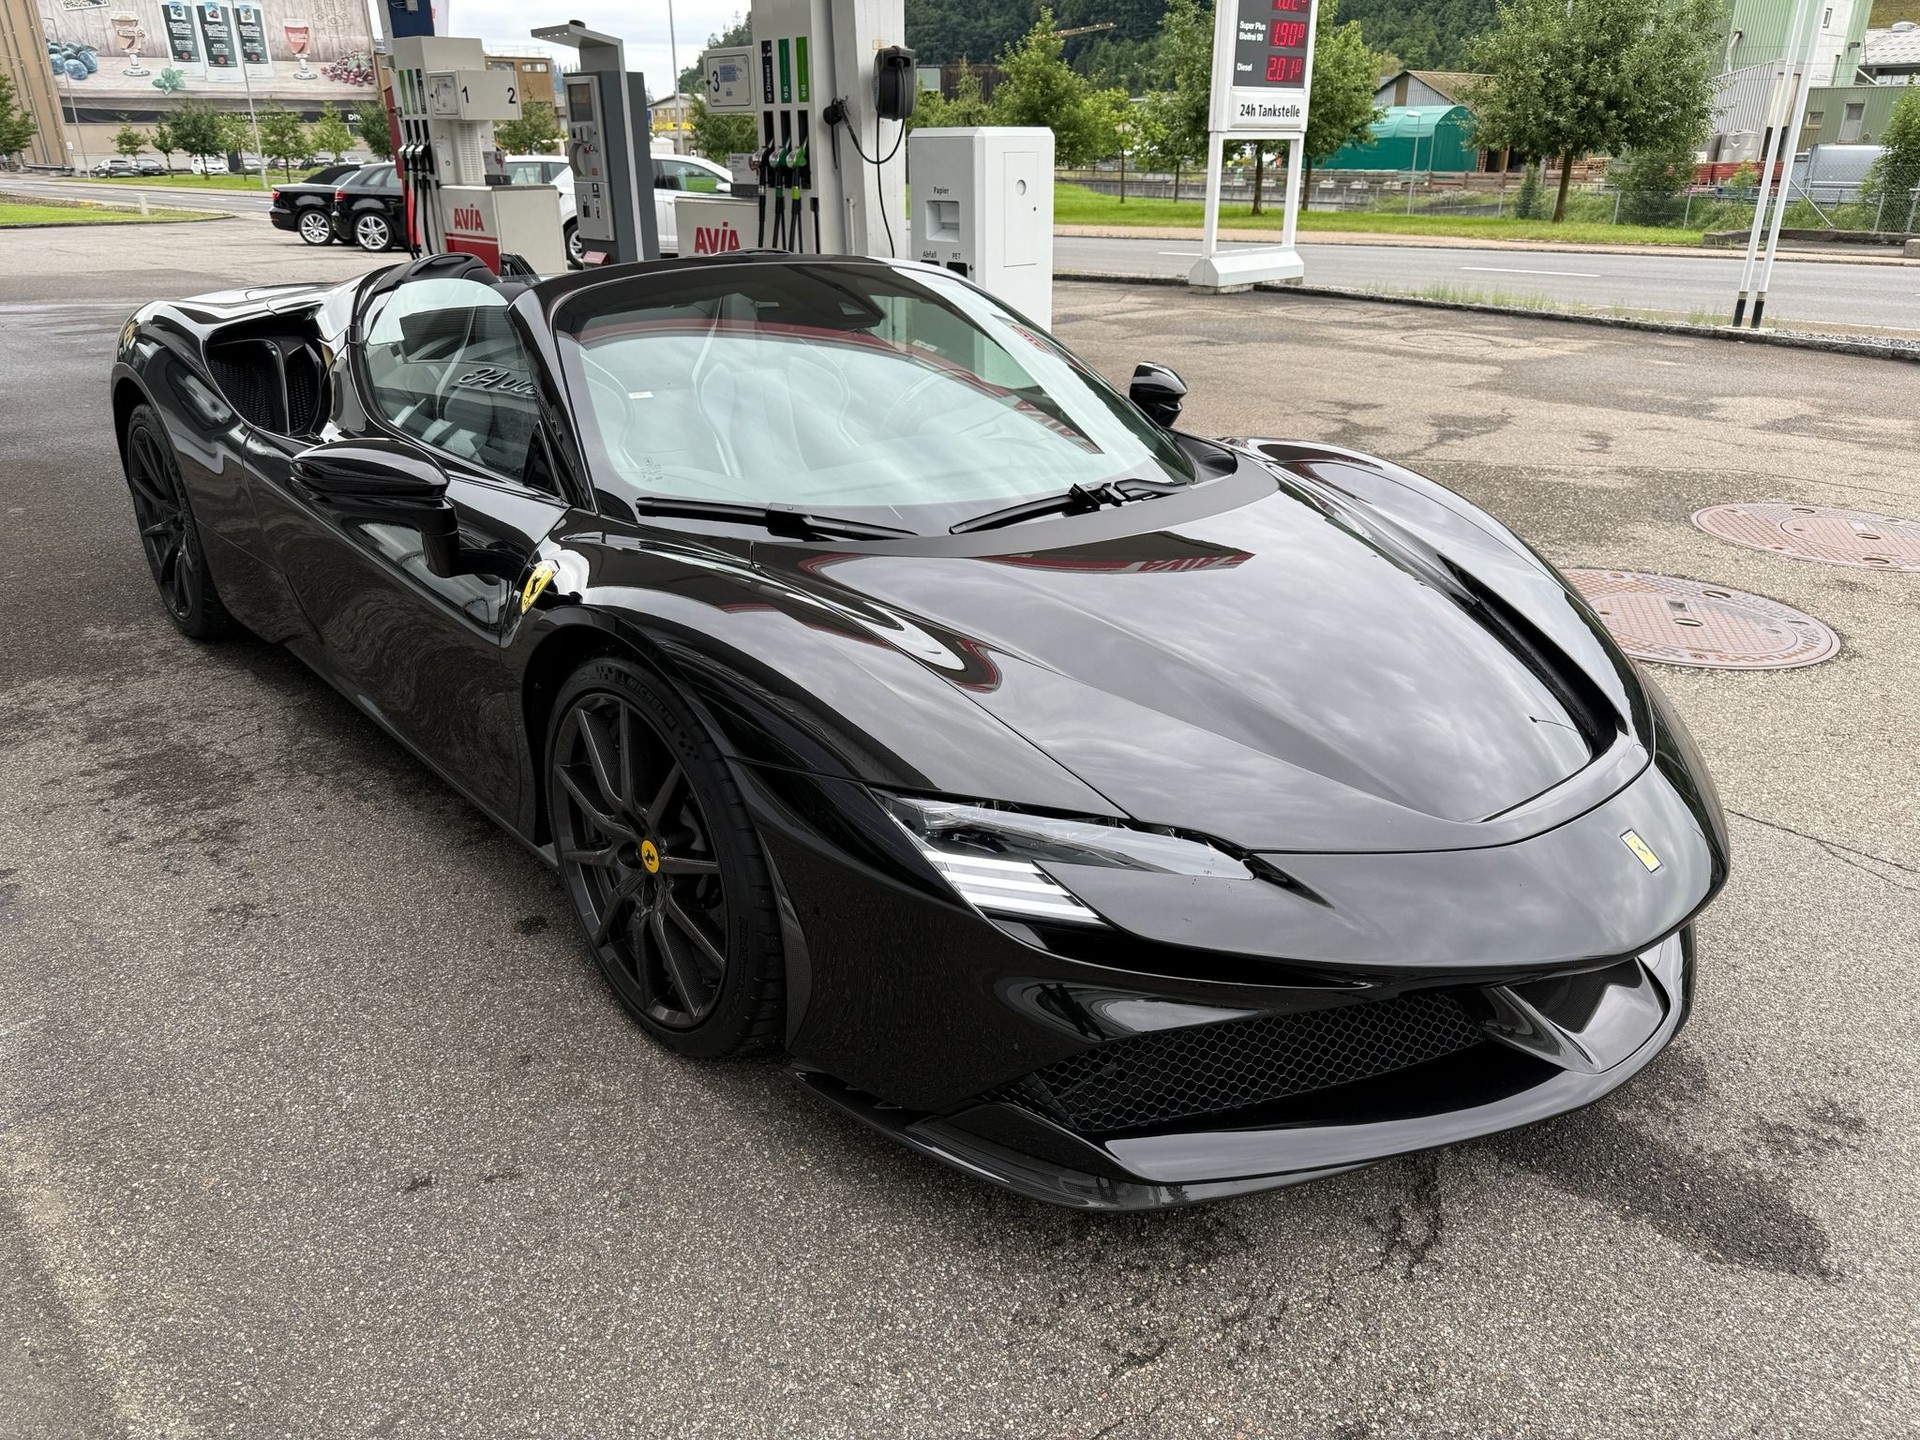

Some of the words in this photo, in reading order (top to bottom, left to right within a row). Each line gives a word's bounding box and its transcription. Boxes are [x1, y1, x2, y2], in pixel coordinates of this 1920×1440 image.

[1255, 22, 1266, 30] Plus
[1237, 63, 1252, 71] Diesel
[712, 70, 720, 93] 3
[461, 86, 470, 104] 1
[507, 87, 517, 104] 2
[1240, 104, 1256, 117] 24h
[1258, 104, 1301, 118] Tankstelle
[933, 186, 950, 196] Papier
[454, 203, 485, 232] AVIA
[694, 221, 741, 254] AVIA
[922, 250, 937, 259] Abfall
[951, 252, 961, 260] PET
[626, 676, 678, 733] MICHELIN
